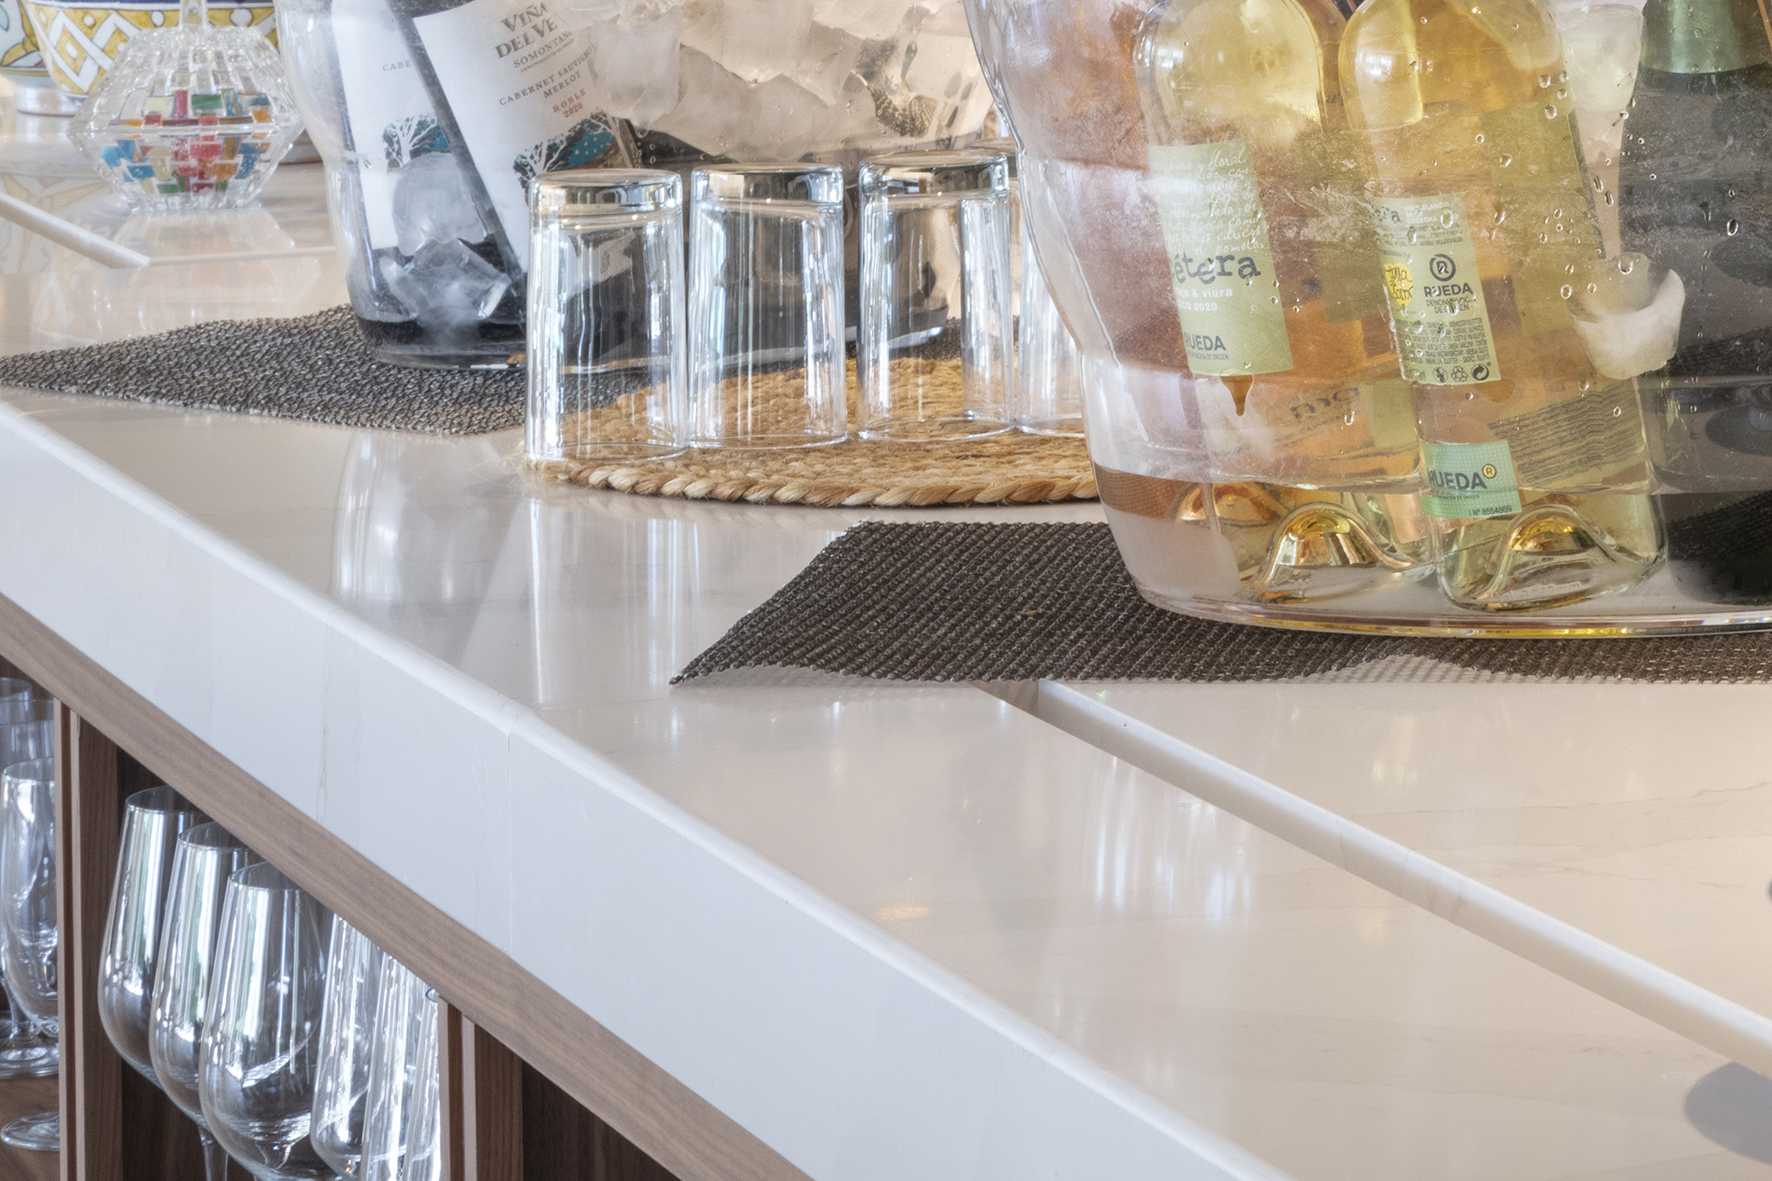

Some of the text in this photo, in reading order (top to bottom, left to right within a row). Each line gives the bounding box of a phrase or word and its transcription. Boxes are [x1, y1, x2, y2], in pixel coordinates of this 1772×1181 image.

[501, 2, 548, 32] VIÑA
[494, 32, 536, 59] DEL
[531, 17, 558, 38] VE
[382, 60, 412, 72] CABE
[499, 74, 555, 106] CABERNET
[543, 70, 581, 99] MERLOT
[563, 102, 583, 118] 2020
[1202, 288, 1233, 299] viura
[1424, 282, 1474, 298] RUEDA
[1194, 302, 1218, 312] 2020
[1184, 332, 1226, 351] RUEDA
